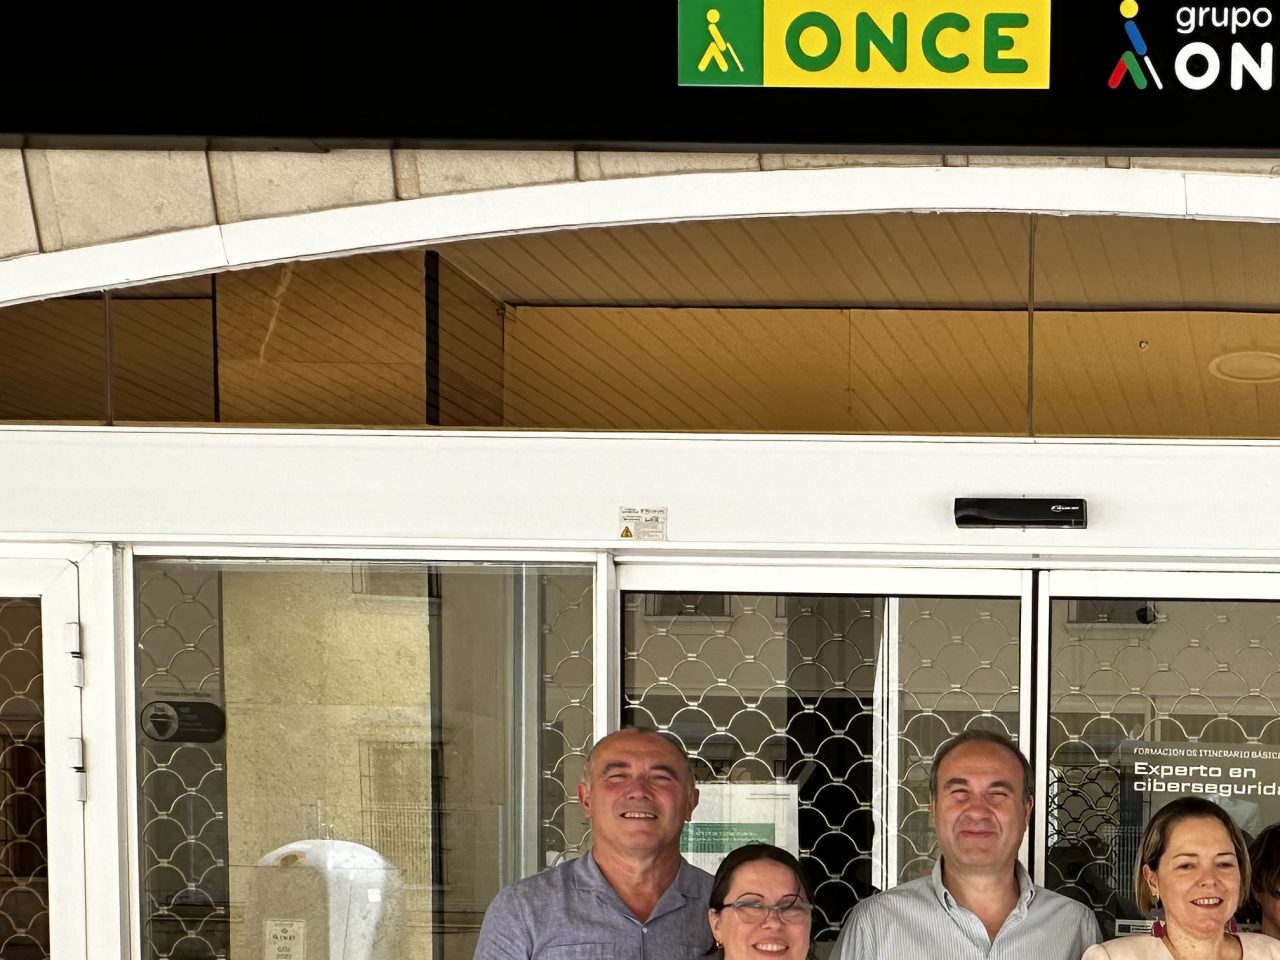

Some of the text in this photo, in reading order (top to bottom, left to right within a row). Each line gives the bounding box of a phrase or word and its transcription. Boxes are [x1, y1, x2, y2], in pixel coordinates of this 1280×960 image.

[1176, 6, 1273, 35] grupo
[785, 11, 1029, 73] ONCE
[1187, 749, 1197, 757] DE
[1199, 749, 1250, 758] ITINERARIO
[1134, 761, 1256, 778] Experto en
